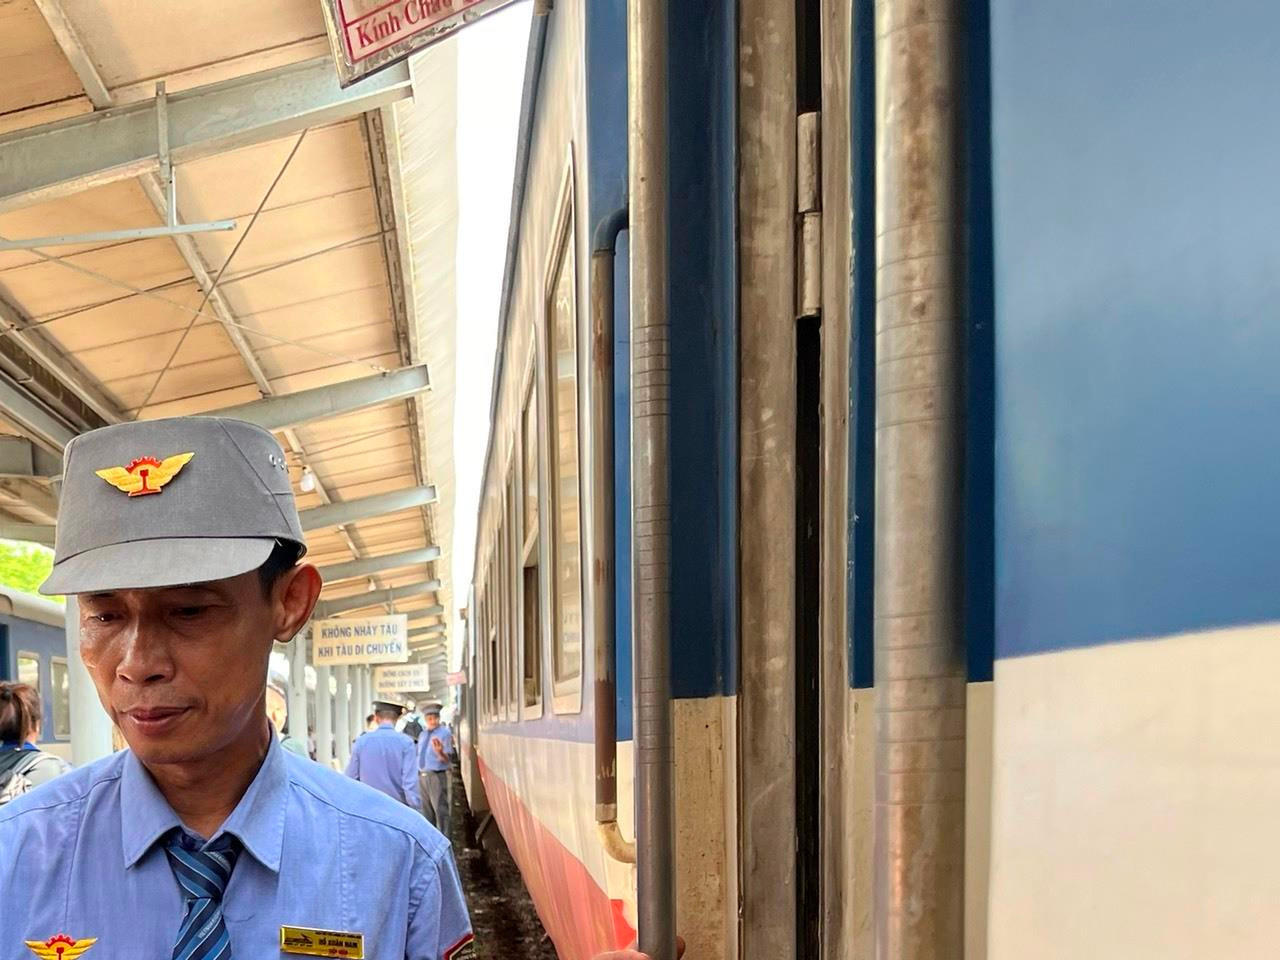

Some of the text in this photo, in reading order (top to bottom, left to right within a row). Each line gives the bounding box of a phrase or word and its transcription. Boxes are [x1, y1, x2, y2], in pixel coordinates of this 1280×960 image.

[355, 12, 401, 48] Kính
[322, 622, 398, 639] KHÔNG NHẢY TÀU
[318, 647, 333, 658] KHI
[336, 642, 352, 656] TÀU
[355, 645, 365, 655] ĐI
